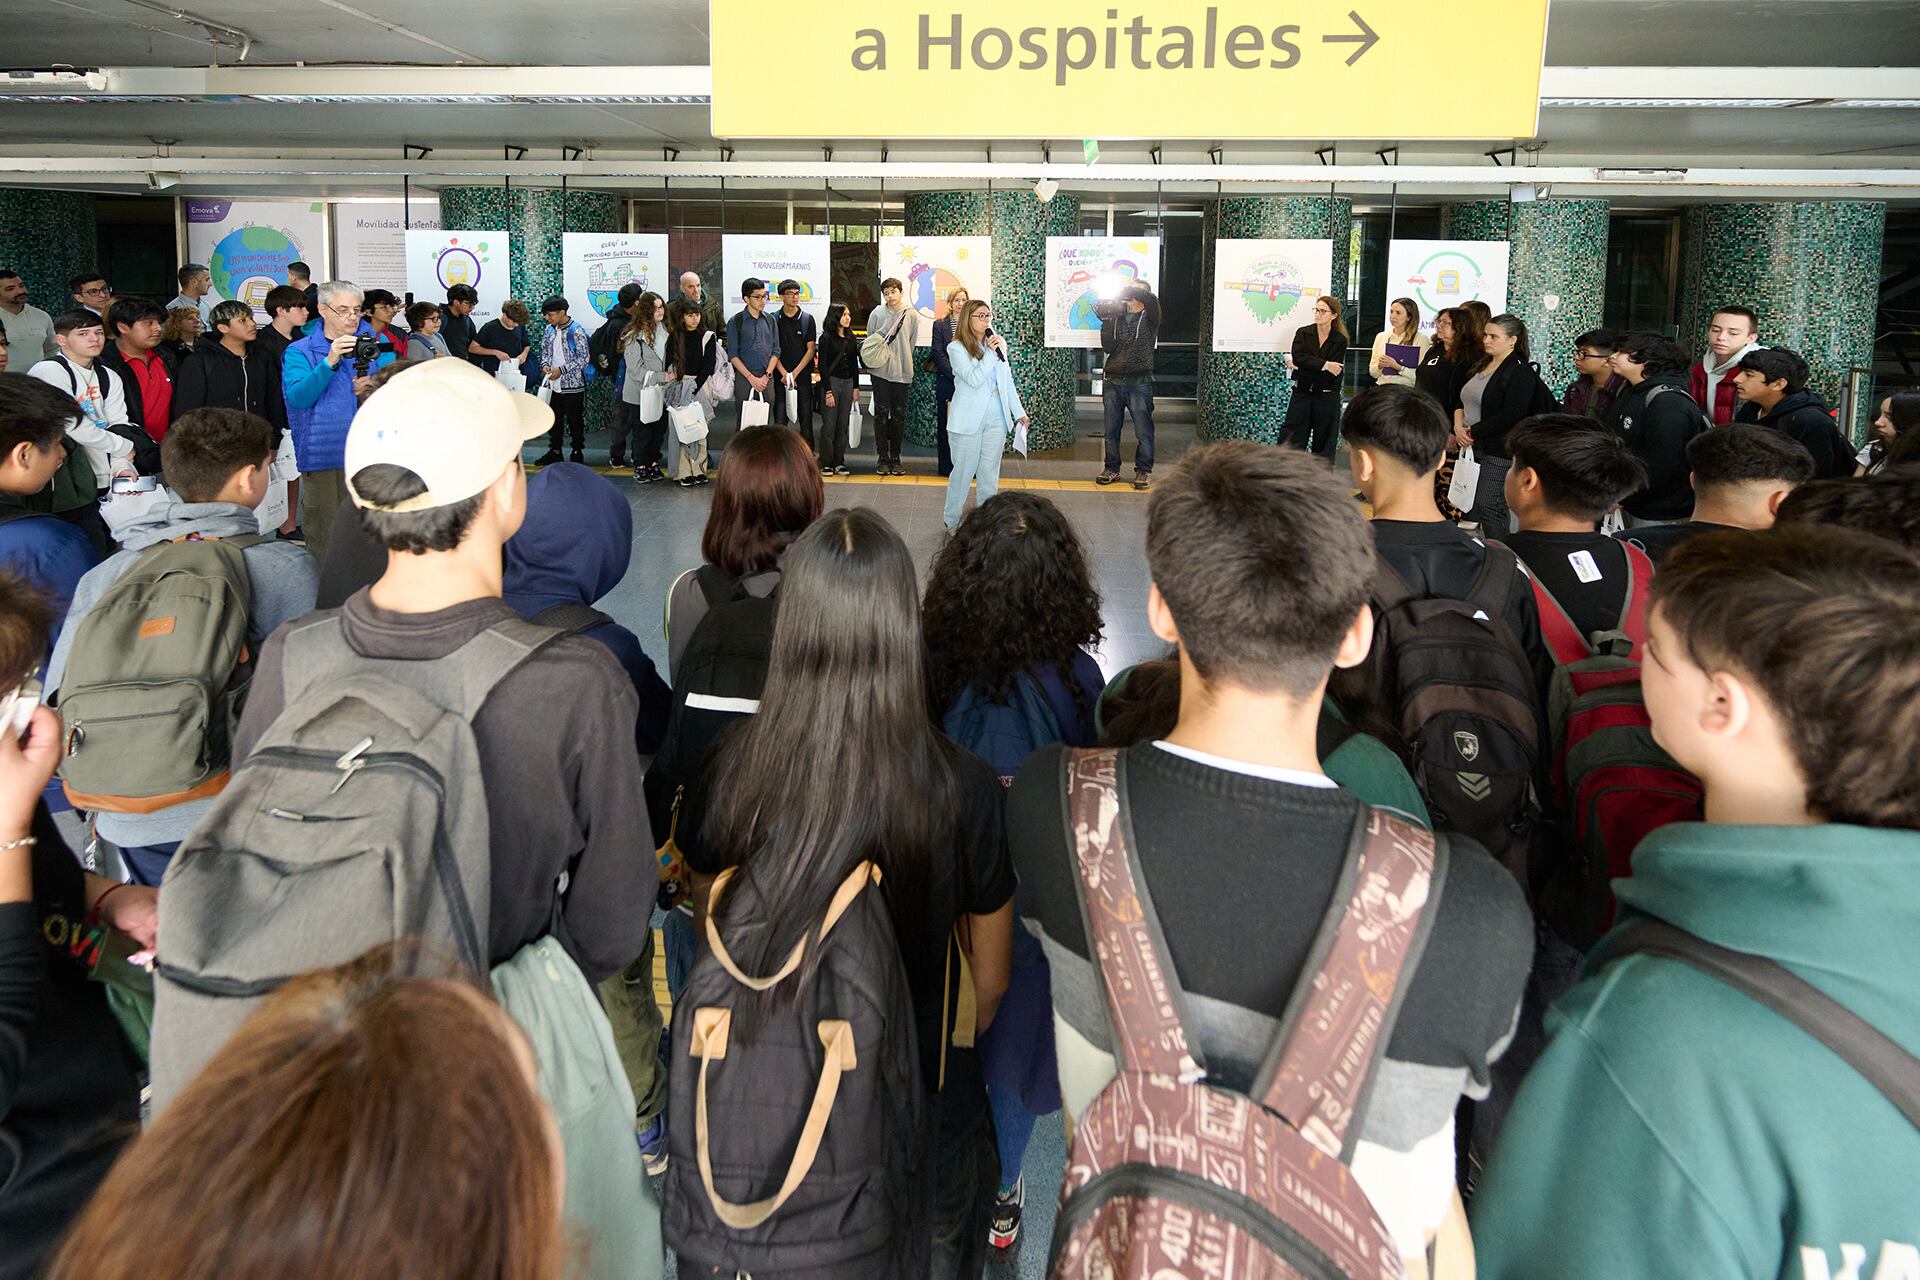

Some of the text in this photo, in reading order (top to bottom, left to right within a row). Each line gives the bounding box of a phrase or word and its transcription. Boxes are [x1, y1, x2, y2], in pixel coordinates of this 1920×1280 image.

[851, 6, 1302, 86] a Hospitales
[191, 206, 214, 214] Emova
[356, 219, 399, 229] Movilidad
[743, 250, 752, 259] ES
[755, 250, 776, 259] HORA
[752, 261, 812, 271] TRANSFORMARNOS
[1160, 1204, 1193, 1268] 400
